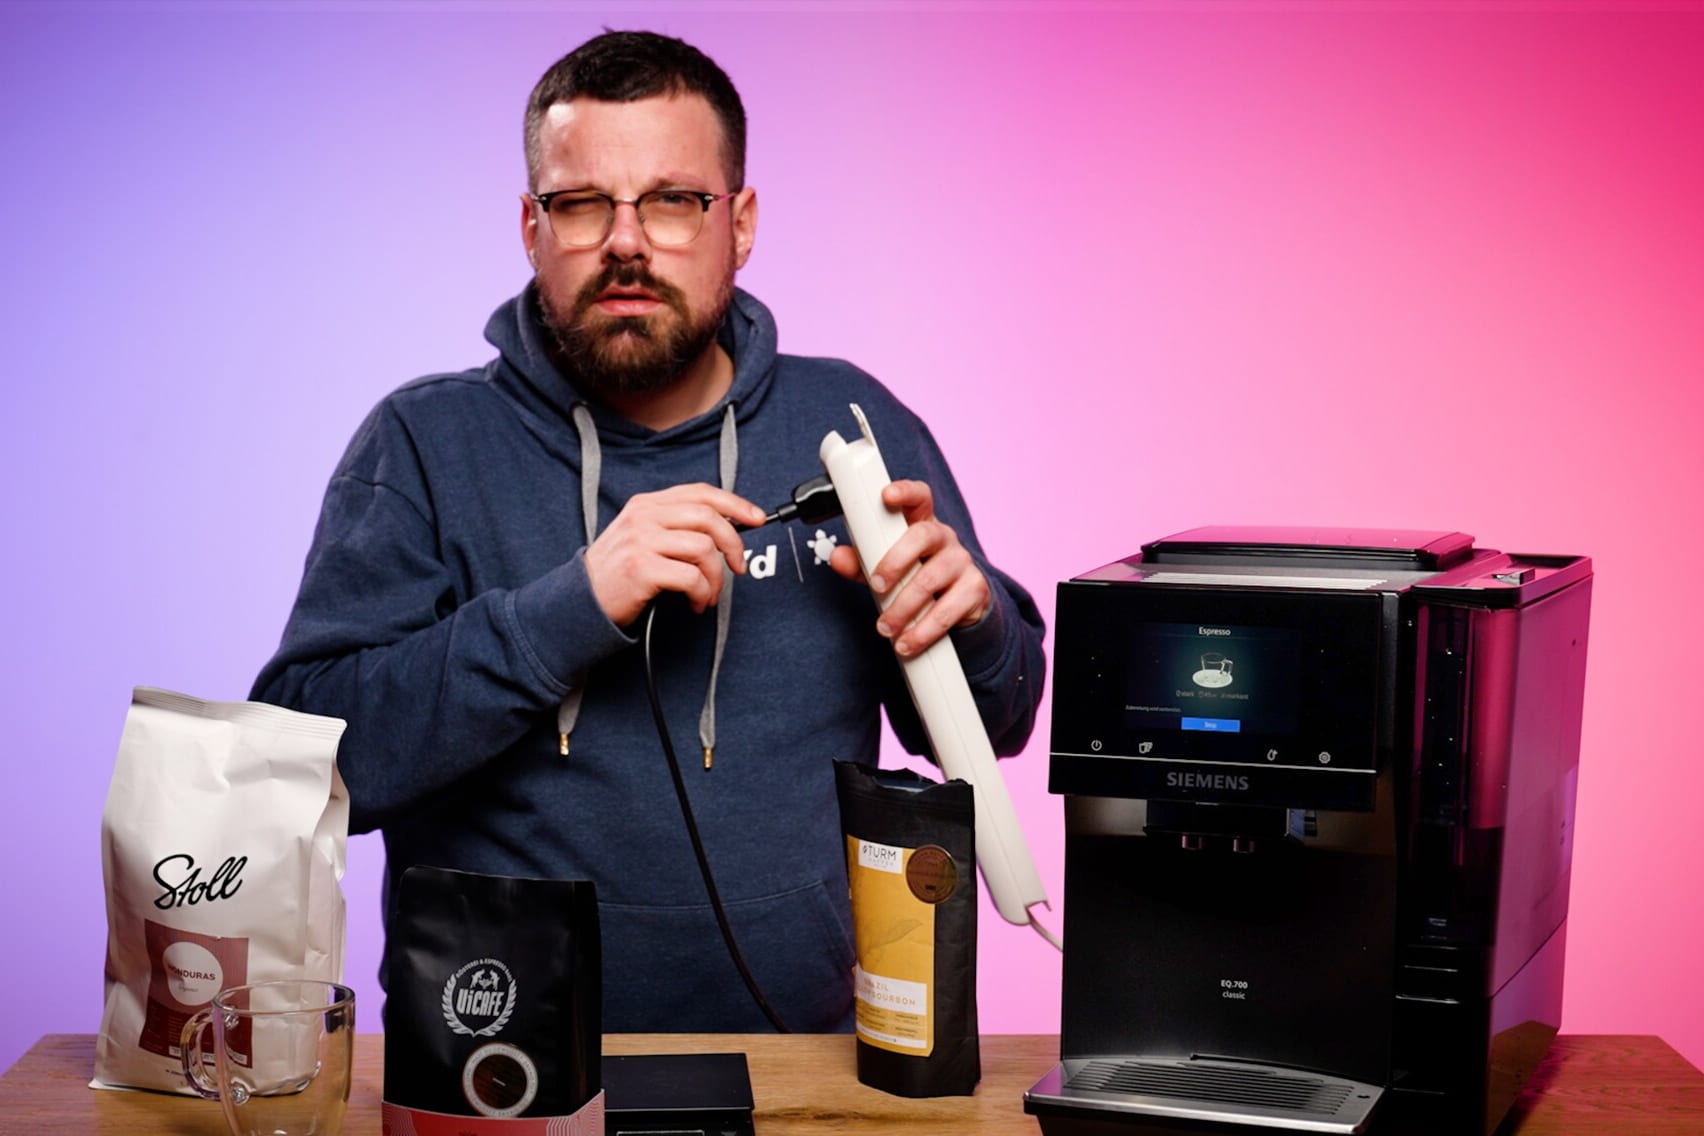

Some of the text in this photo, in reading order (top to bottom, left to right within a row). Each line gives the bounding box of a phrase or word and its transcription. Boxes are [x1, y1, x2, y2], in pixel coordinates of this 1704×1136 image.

[1198, 626, 1231, 637] Espresso
[1167, 771, 1249, 791] SIEMENS
[152, 853, 248, 910] Stoll
[1220, 979, 1249, 990] EQ.700
[1222, 990, 1246, 1000] classic
